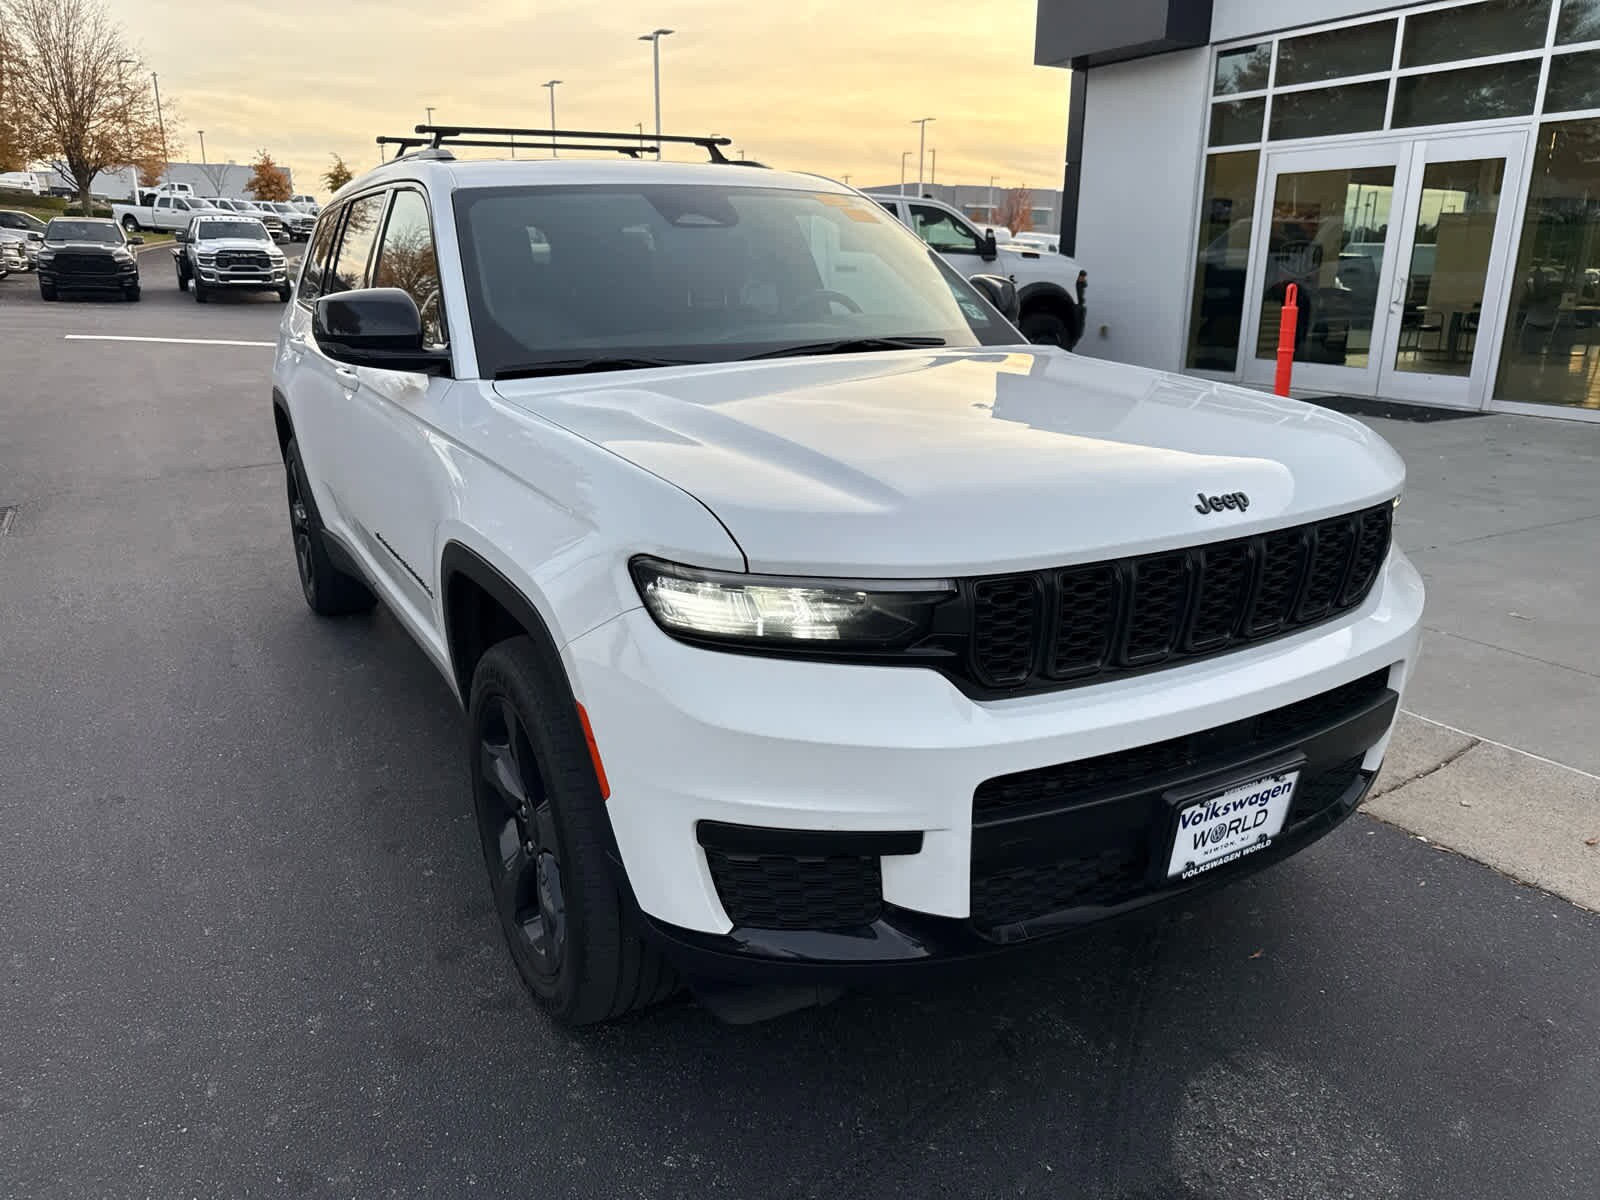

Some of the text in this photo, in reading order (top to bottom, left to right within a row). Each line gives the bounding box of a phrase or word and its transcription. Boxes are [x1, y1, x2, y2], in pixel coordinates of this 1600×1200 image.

[1195, 491, 1249, 515] Jeep
[1181, 781, 1292, 829] Volkswagen
[1193, 809, 1269, 850] WORLD
[1182, 840, 1271, 879] VOLKSWAGEN WORLD
